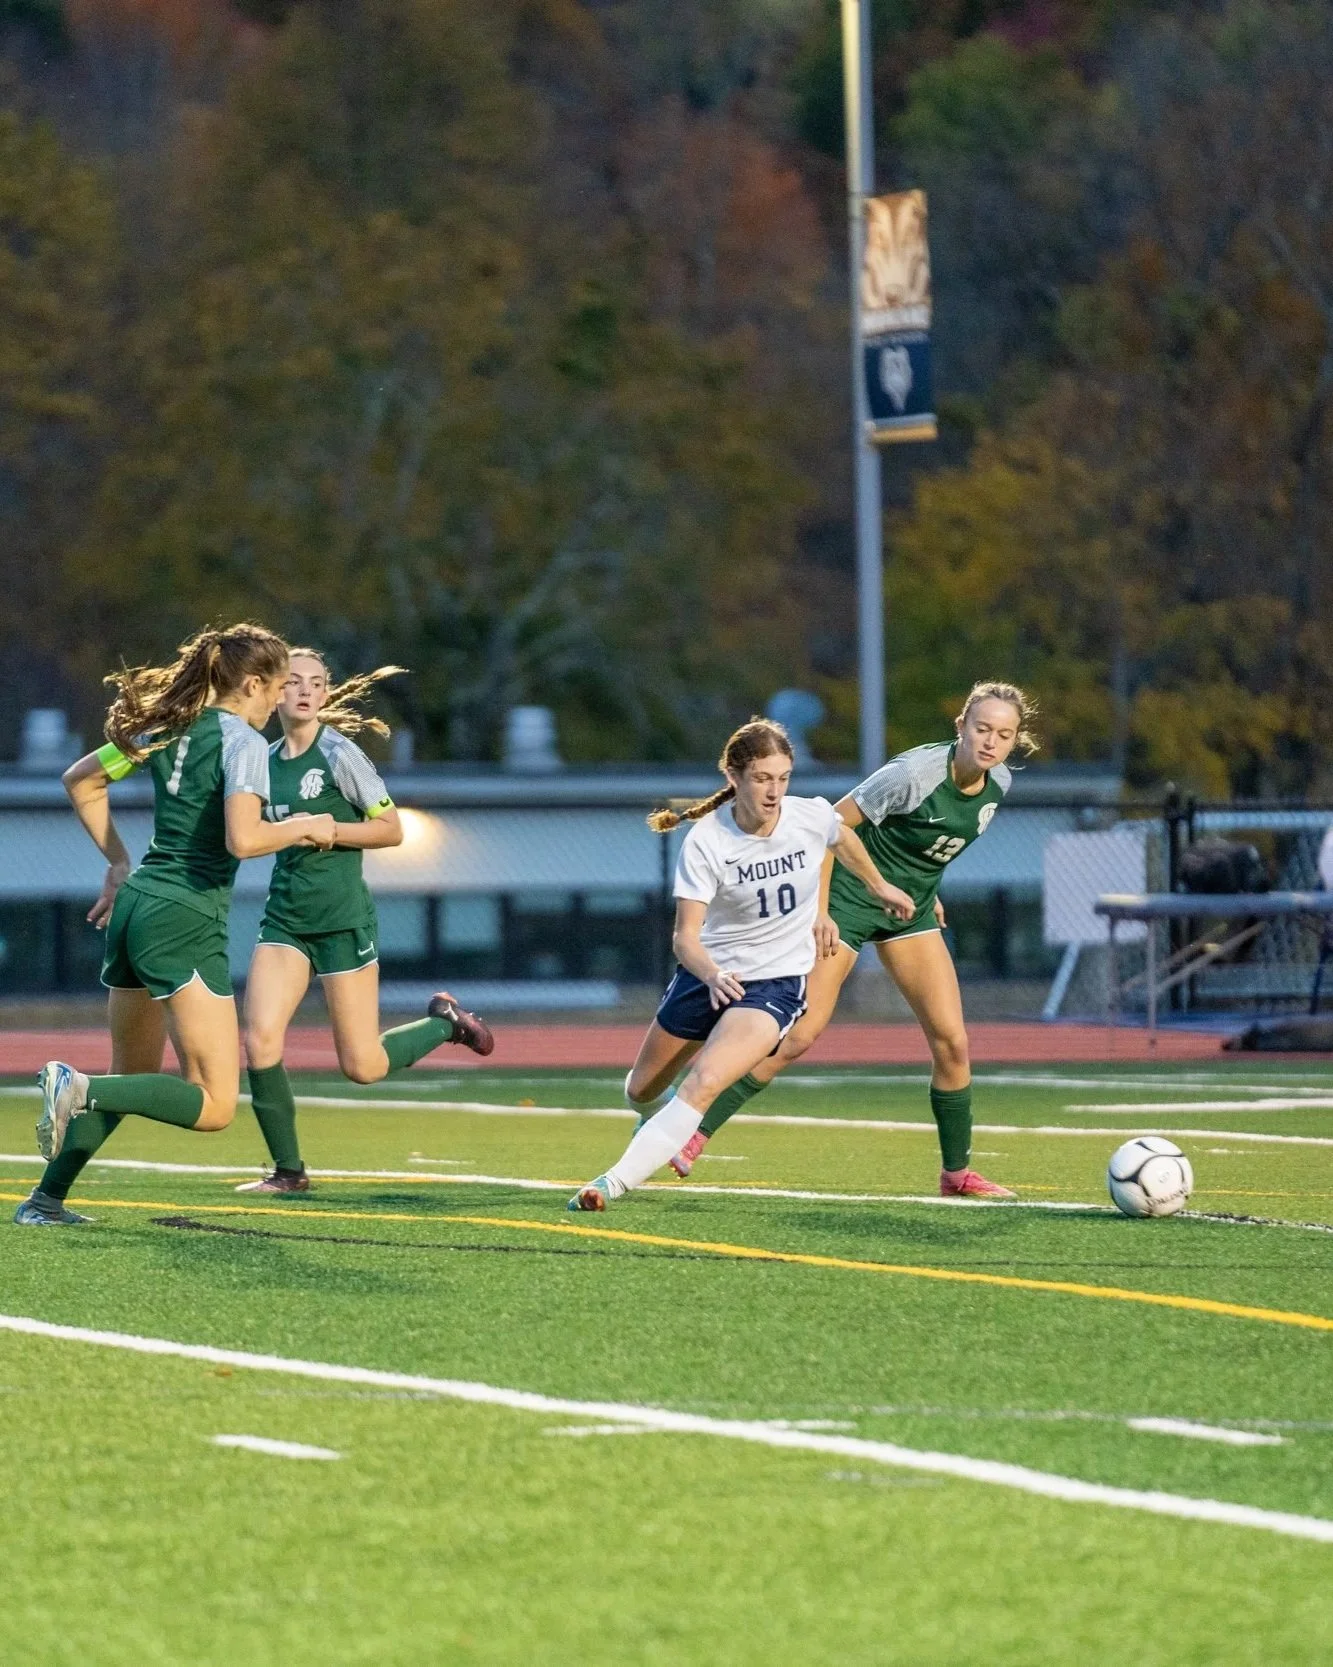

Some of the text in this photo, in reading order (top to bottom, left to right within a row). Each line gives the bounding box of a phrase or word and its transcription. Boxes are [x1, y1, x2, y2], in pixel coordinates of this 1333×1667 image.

[166, 735, 192, 796] 1
[922, 834, 966, 862] 13
[737, 850, 806, 884] MOUNT
[757, 883, 796, 918] 10
